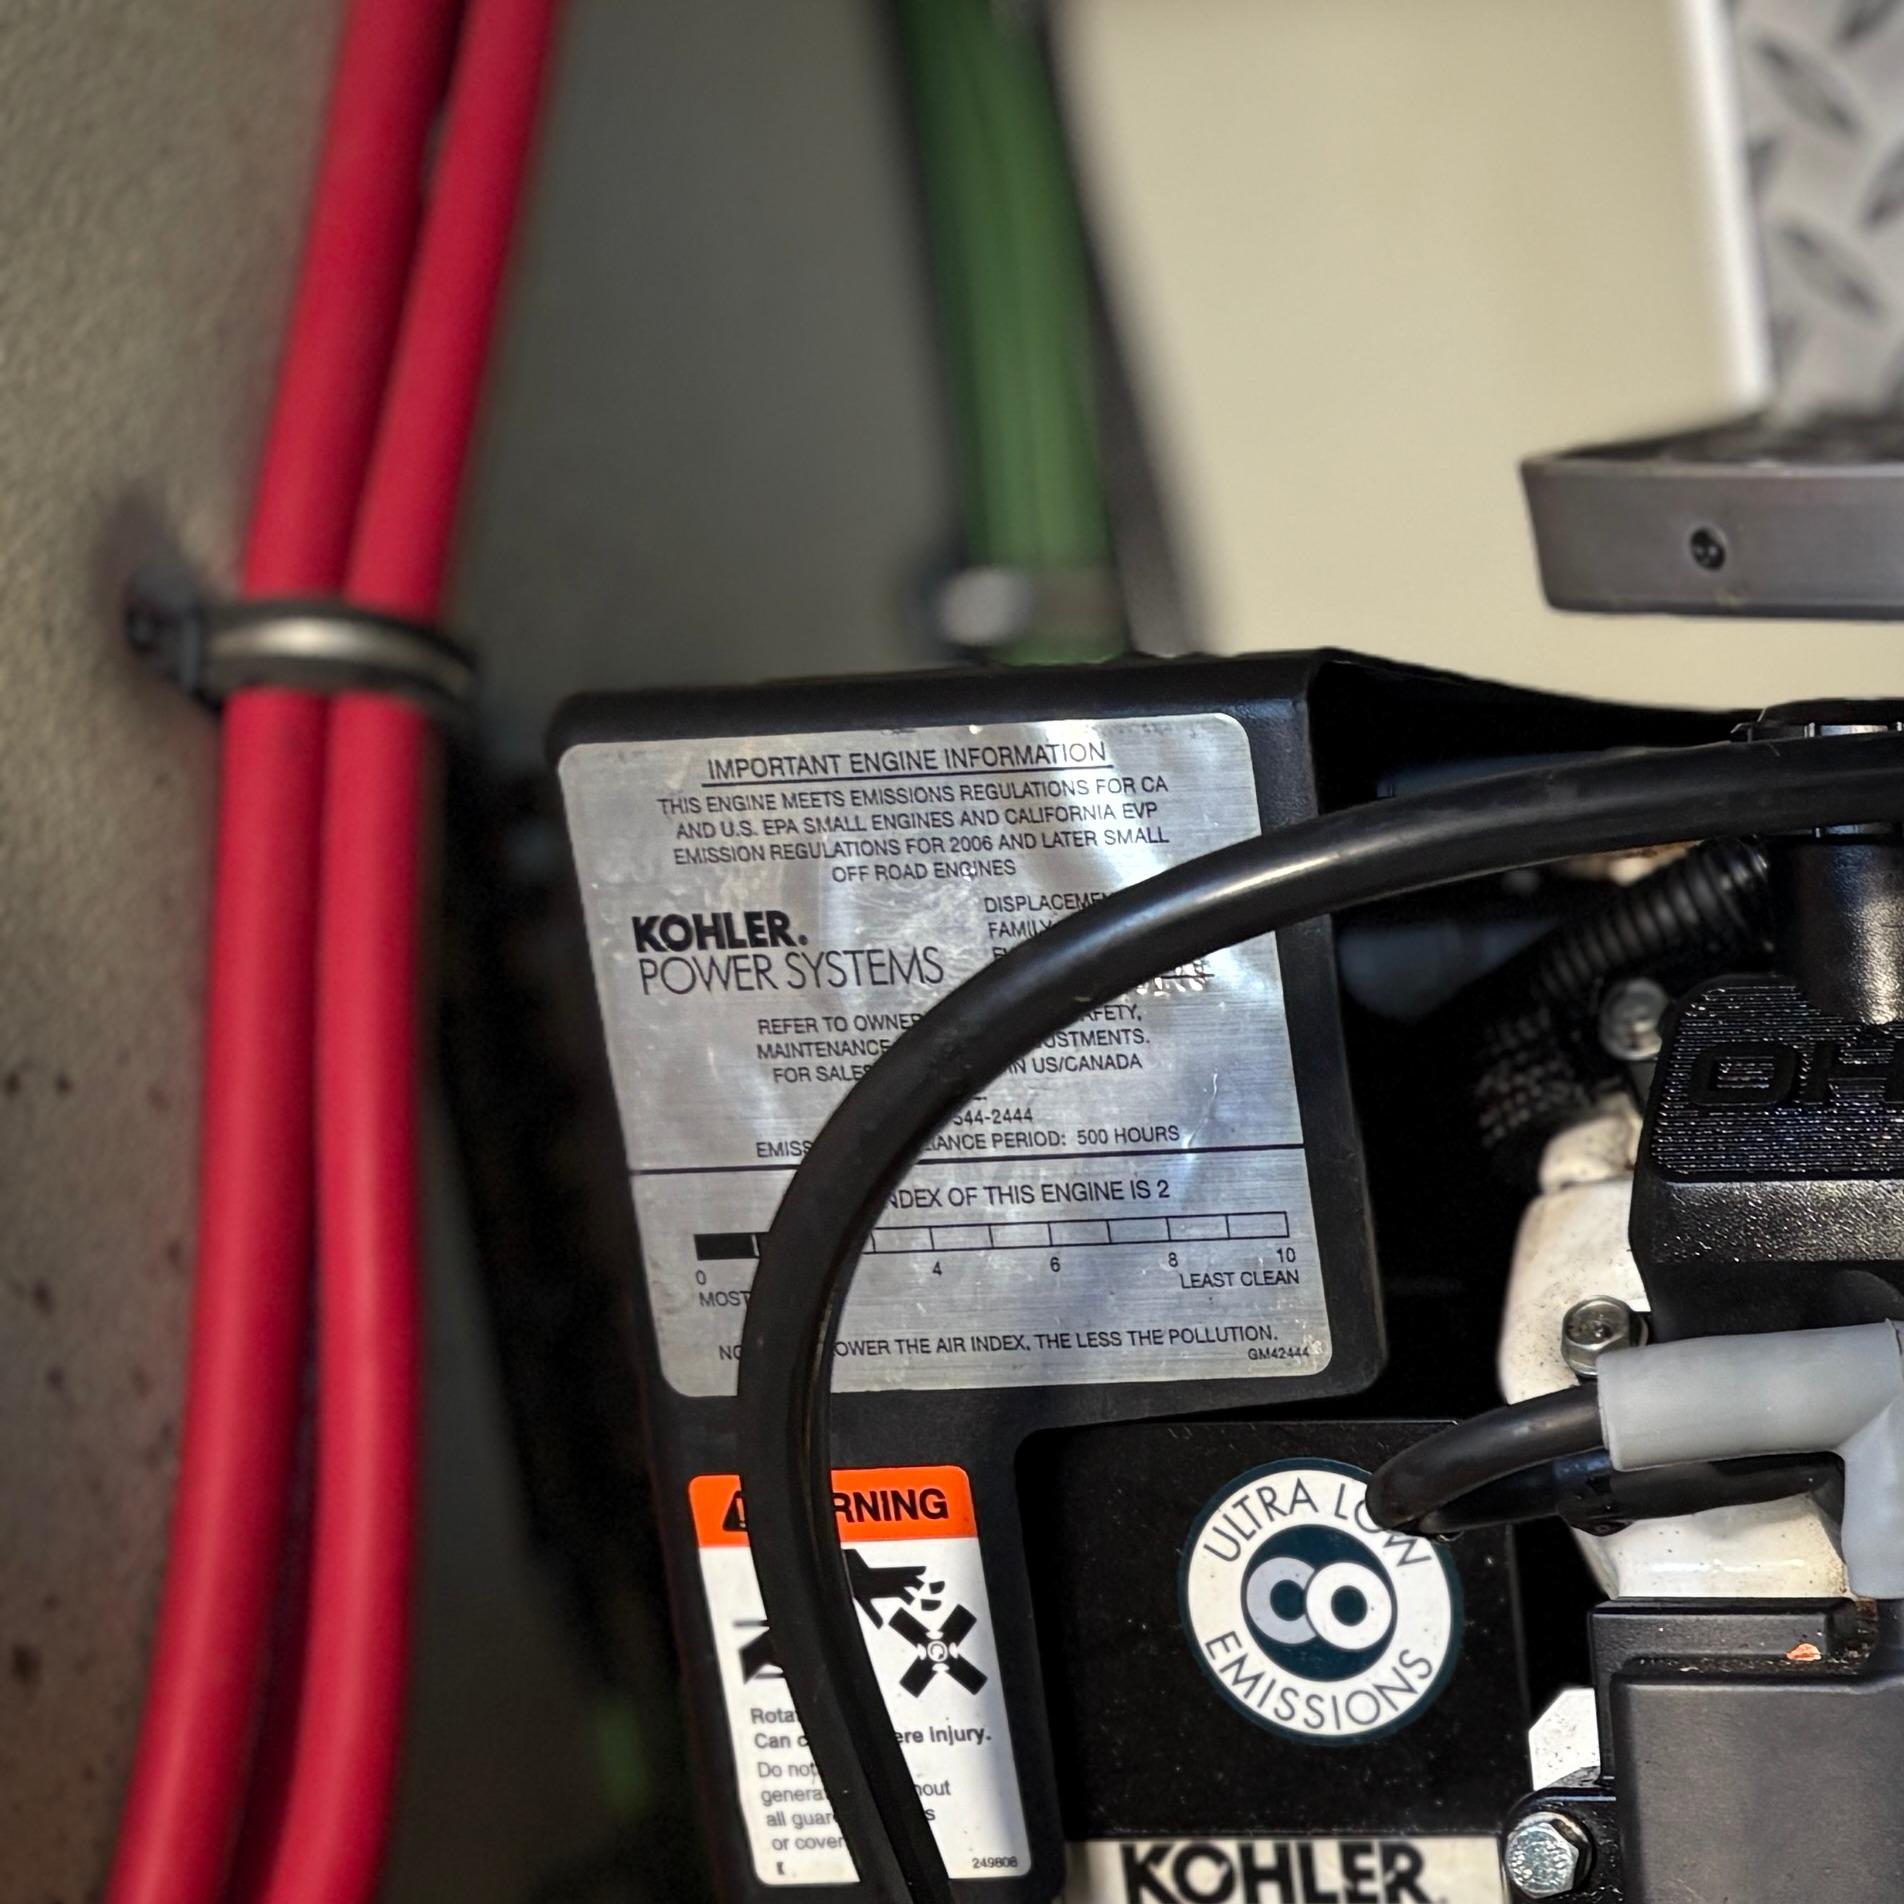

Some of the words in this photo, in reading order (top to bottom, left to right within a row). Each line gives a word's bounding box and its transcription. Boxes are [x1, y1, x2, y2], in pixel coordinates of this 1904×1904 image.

[707, 754, 841, 780] IMPORTANT
[849, 749, 939, 774] ENGINE
[944, 741, 1107, 770] INFORMATION
[657, 797, 703, 816] THIS
[707, 793, 777, 813] ENGINE
[782, 790, 845, 810] MEETS
[851, 785, 954, 807] EMISSIONS
[960, 779, 1090, 801] REGULATIONS
[1096, 777, 1136, 795] FOR
[1140, 775, 1169, 793] CA
[676, 822, 716, 840] AND
[721, 820, 758, 838] U.S.
[763, 818, 799, 836] EPA
[803, 814, 868, 834] SMALL
[872, 811, 954, 830] ENGINES
[959, 808, 999, 827] AND
[1004, 803, 1117, 825] CALIFORNIA
[1122, 801, 1158, 819] EVP
[638, 952, 779, 996] POWER
[784, 945, 945, 989] SYSTEMS
[991, 1130, 1067, 1150] PERIOD:
[1077, 1128, 1109, 1146] 500
[1114, 1125, 1180, 1144] HOURS
[1180, 1271, 1236, 1290] LEAST
[1240, 1268, 1300, 1287] CLEAN
[1169, 1324, 1279, 1345] POLLUTION.
[1247, 1348, 1310, 1361] GM42444
[1204, 1477, 1319, 1564] ULTRA
[1204, 1630, 1433, 1731] EMISSIONS
[972, 1856, 1018, 1869] 249808
